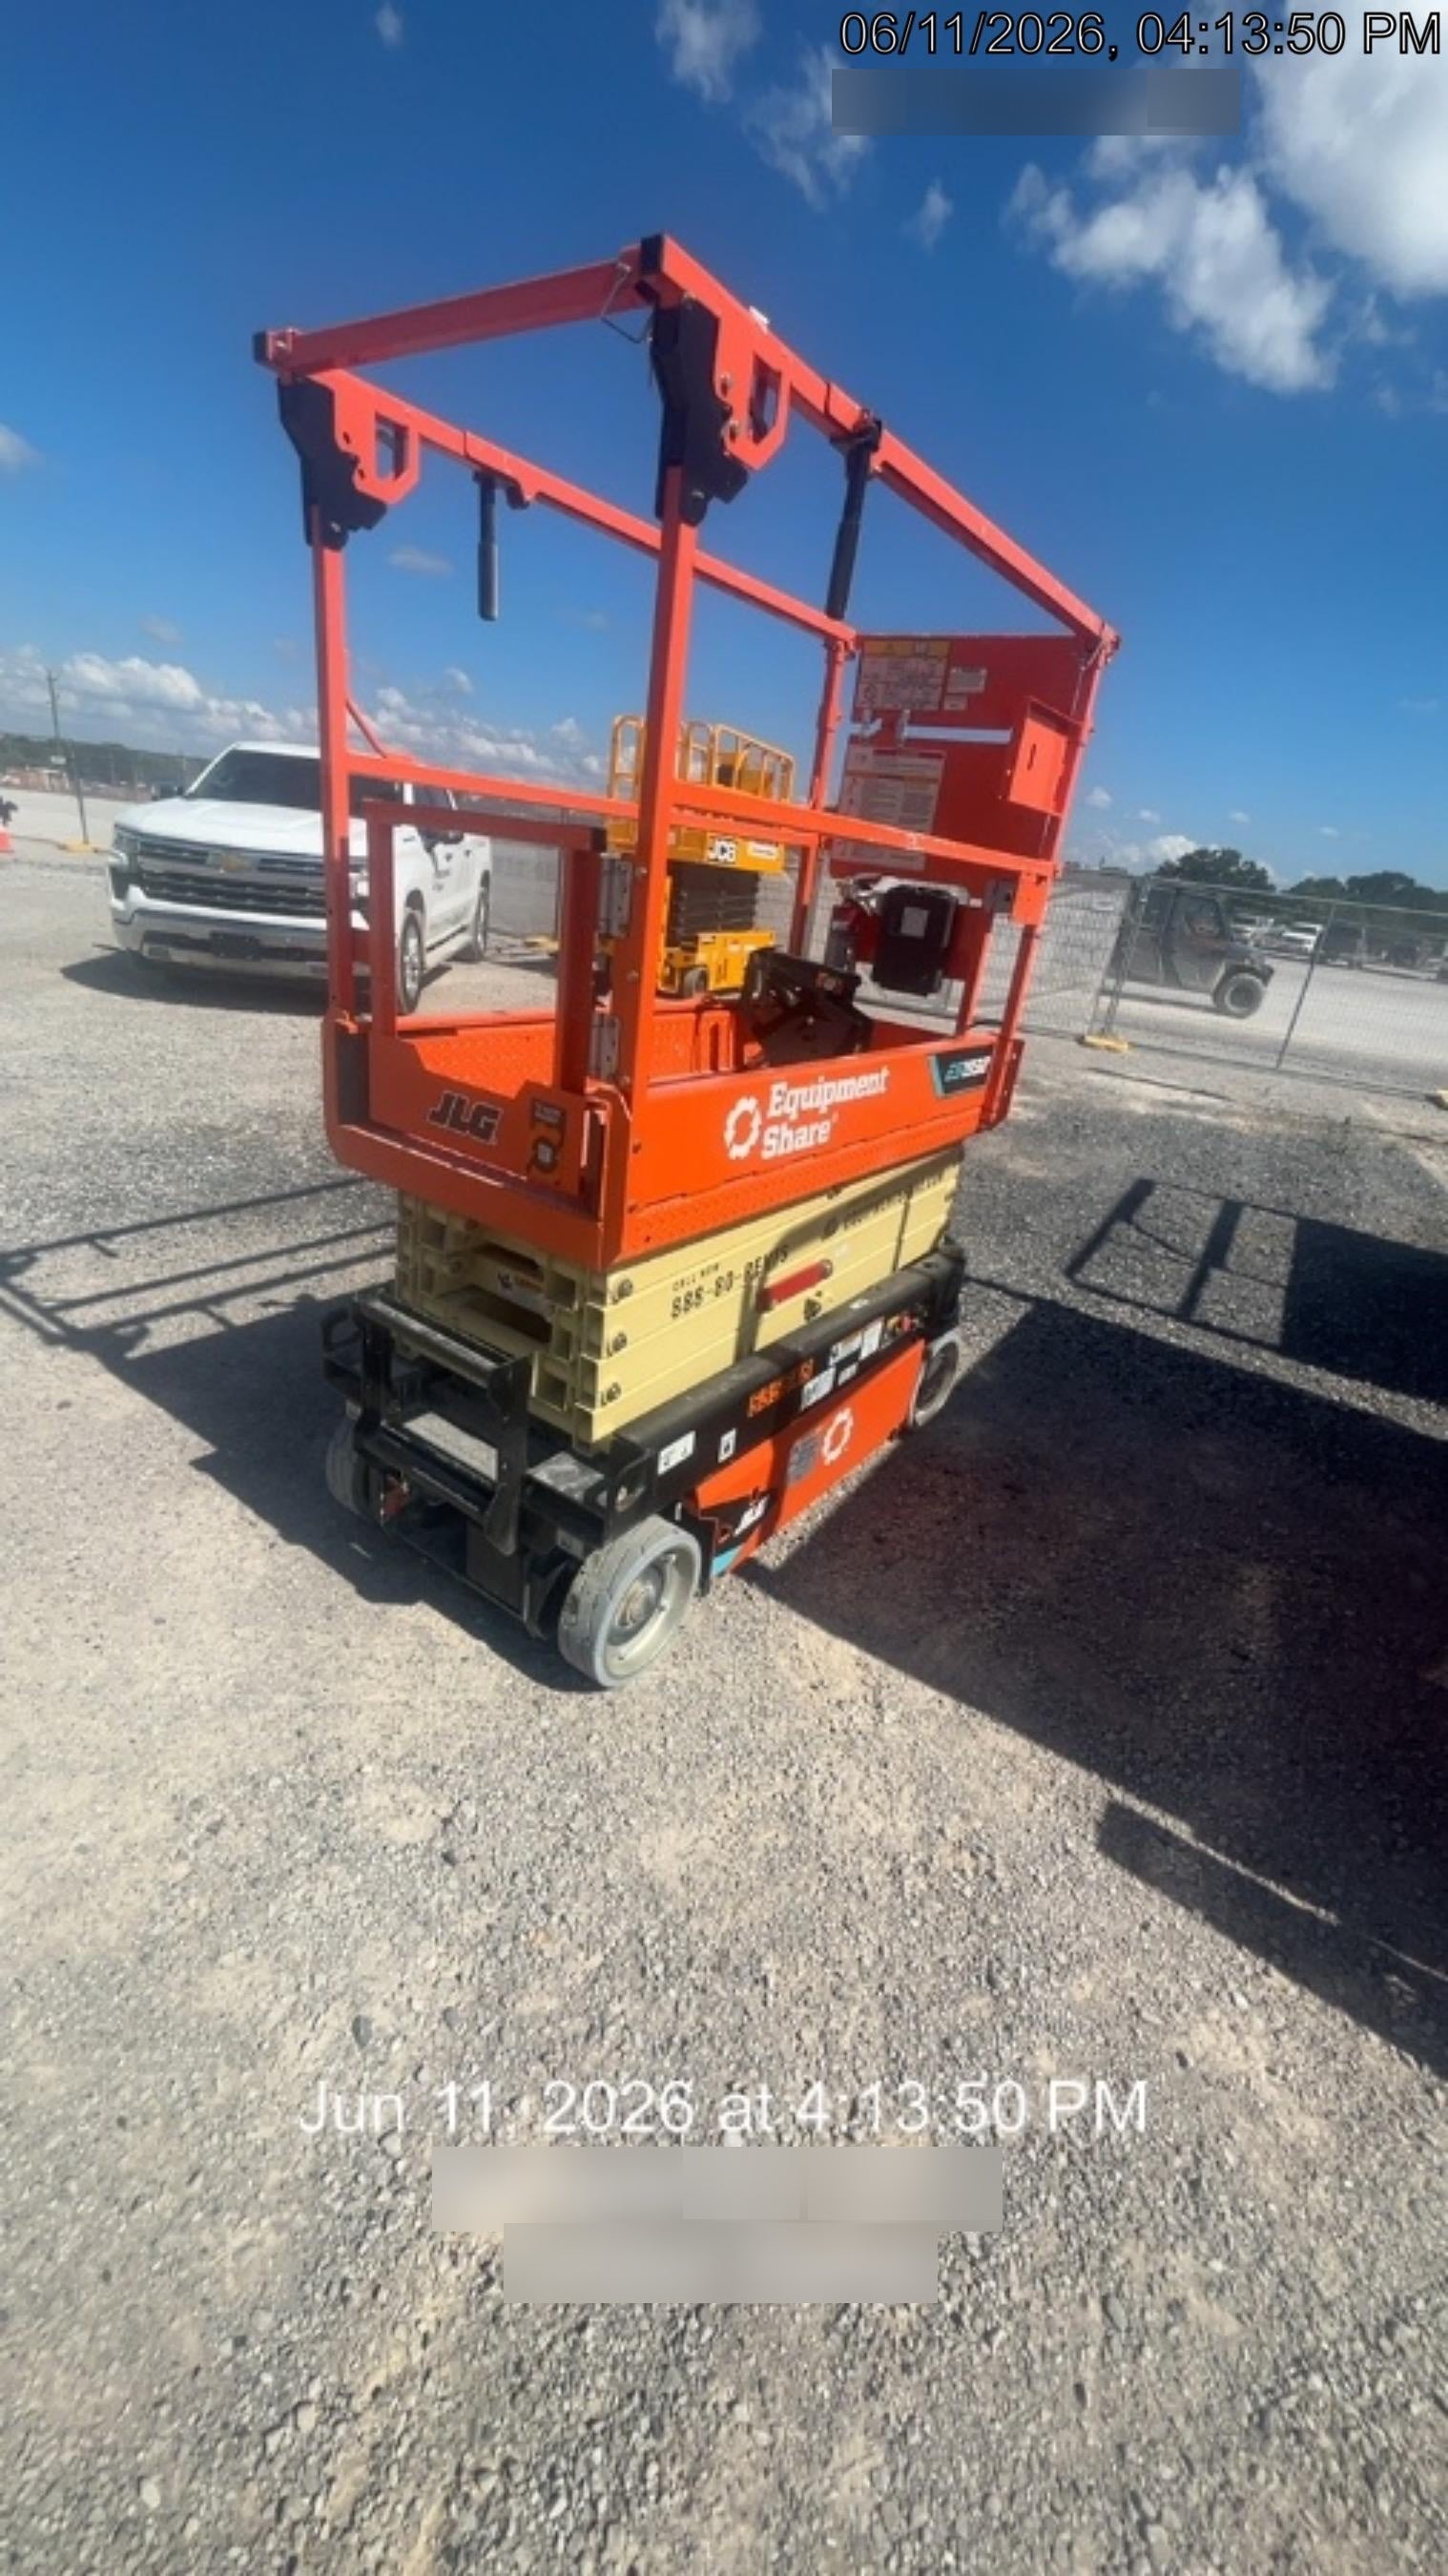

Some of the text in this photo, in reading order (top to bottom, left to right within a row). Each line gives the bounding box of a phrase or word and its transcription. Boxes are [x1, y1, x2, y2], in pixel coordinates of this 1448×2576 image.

[426, 1089, 505, 1146] JLG
[766, 1064, 891, 1121] Equipment
[760, 1118, 833, 1160] Share
